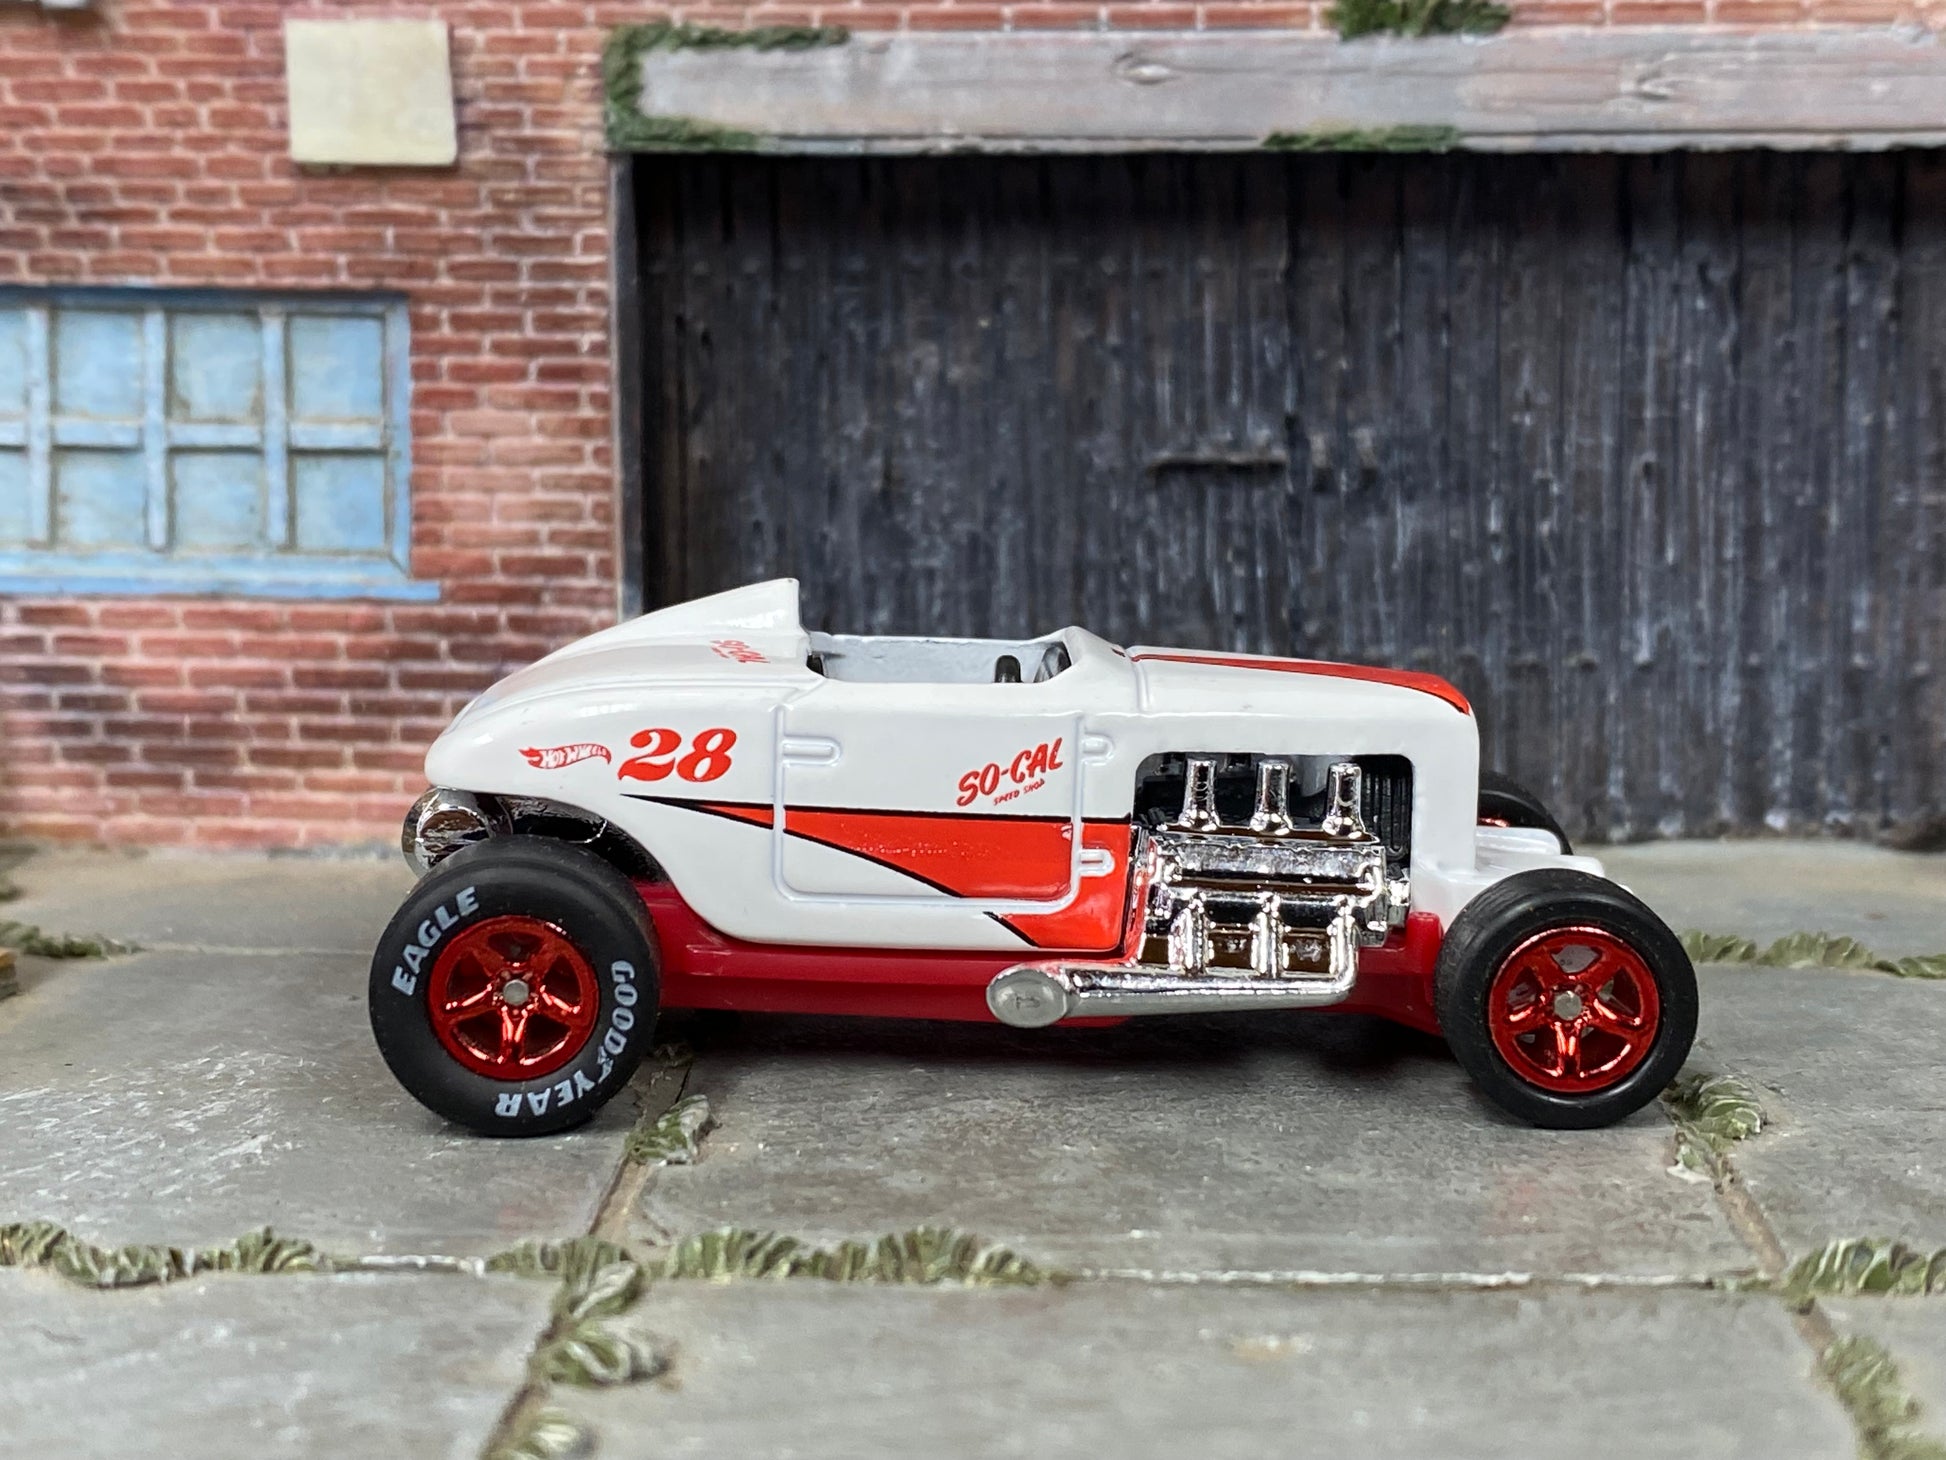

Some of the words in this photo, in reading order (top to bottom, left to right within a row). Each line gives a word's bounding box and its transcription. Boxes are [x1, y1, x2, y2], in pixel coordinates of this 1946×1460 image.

[617, 727, 737, 783] 28
[956, 736, 1063, 807] SO-CAL
[391, 886, 480, 996] EAGLE
